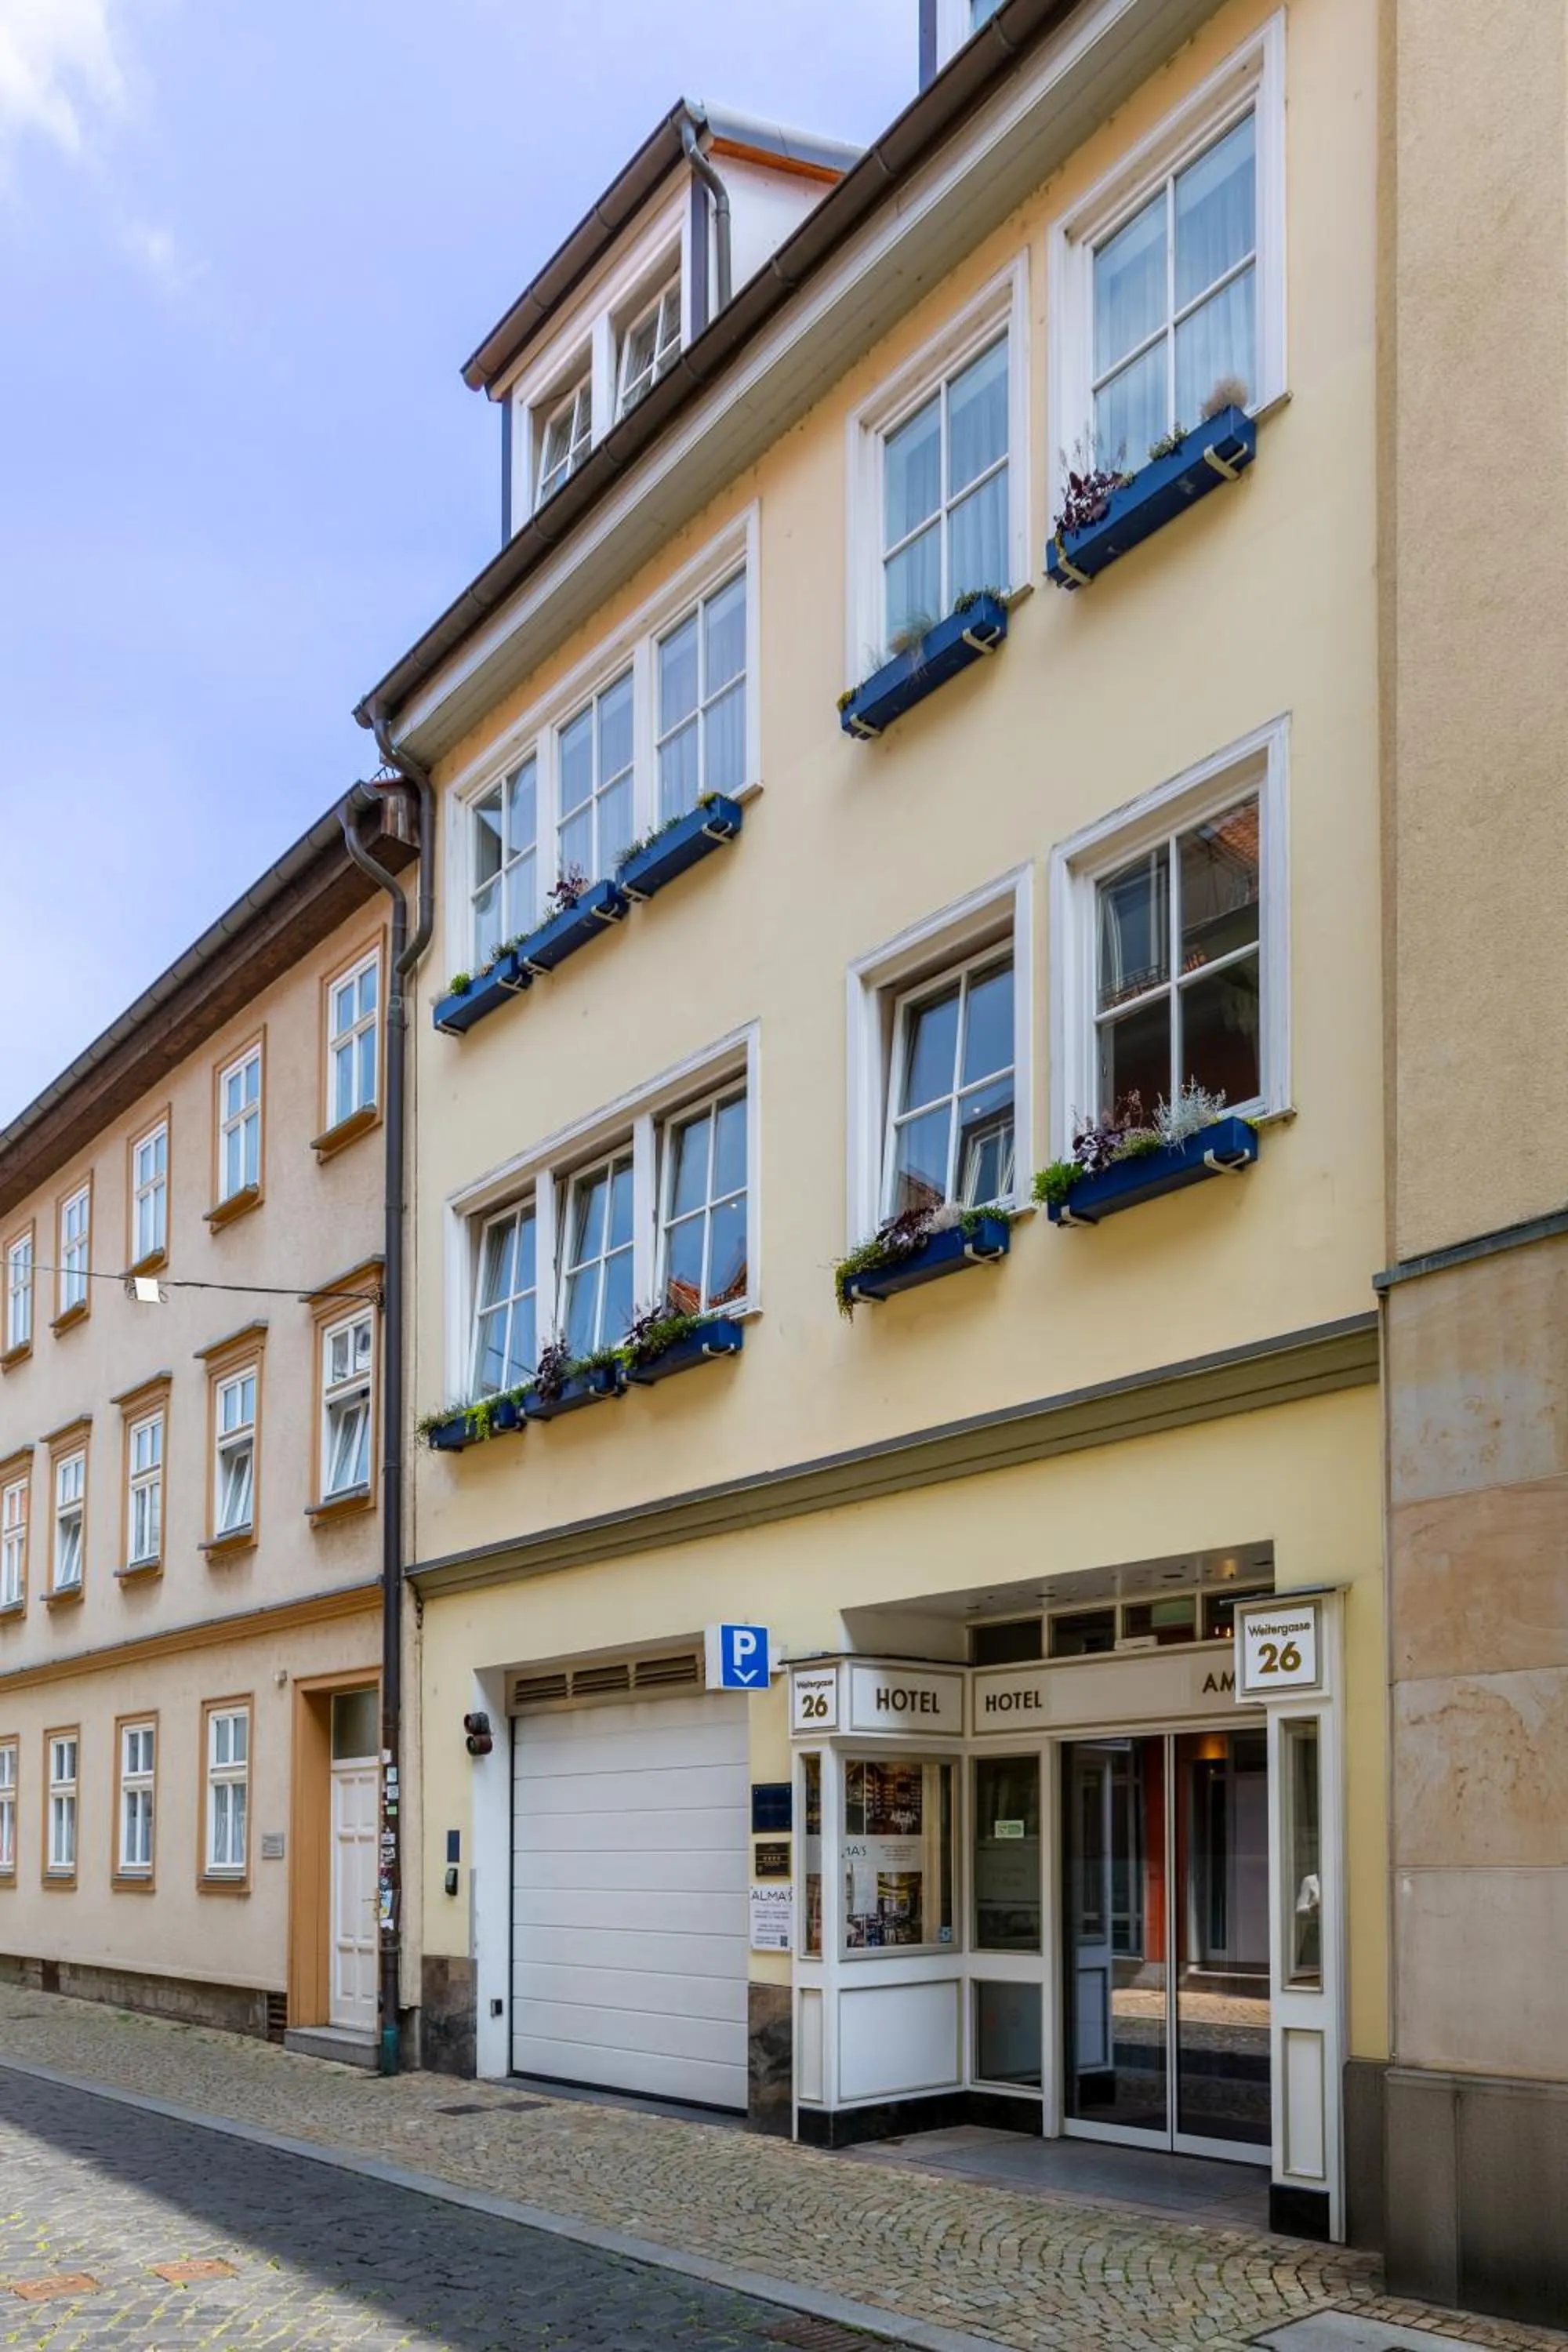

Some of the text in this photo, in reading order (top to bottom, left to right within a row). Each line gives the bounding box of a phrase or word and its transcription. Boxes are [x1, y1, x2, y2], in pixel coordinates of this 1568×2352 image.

[1248, 1621, 1311, 1637] Weitergasse
[733, 1630, 756, 1666] P
[1258, 1641, 1301, 1673] 26
[802, 1693, 829, 1719] 26
[876, 1687, 940, 1714] HOTEL
[985, 1690, 1042, 1712] HOTEL
